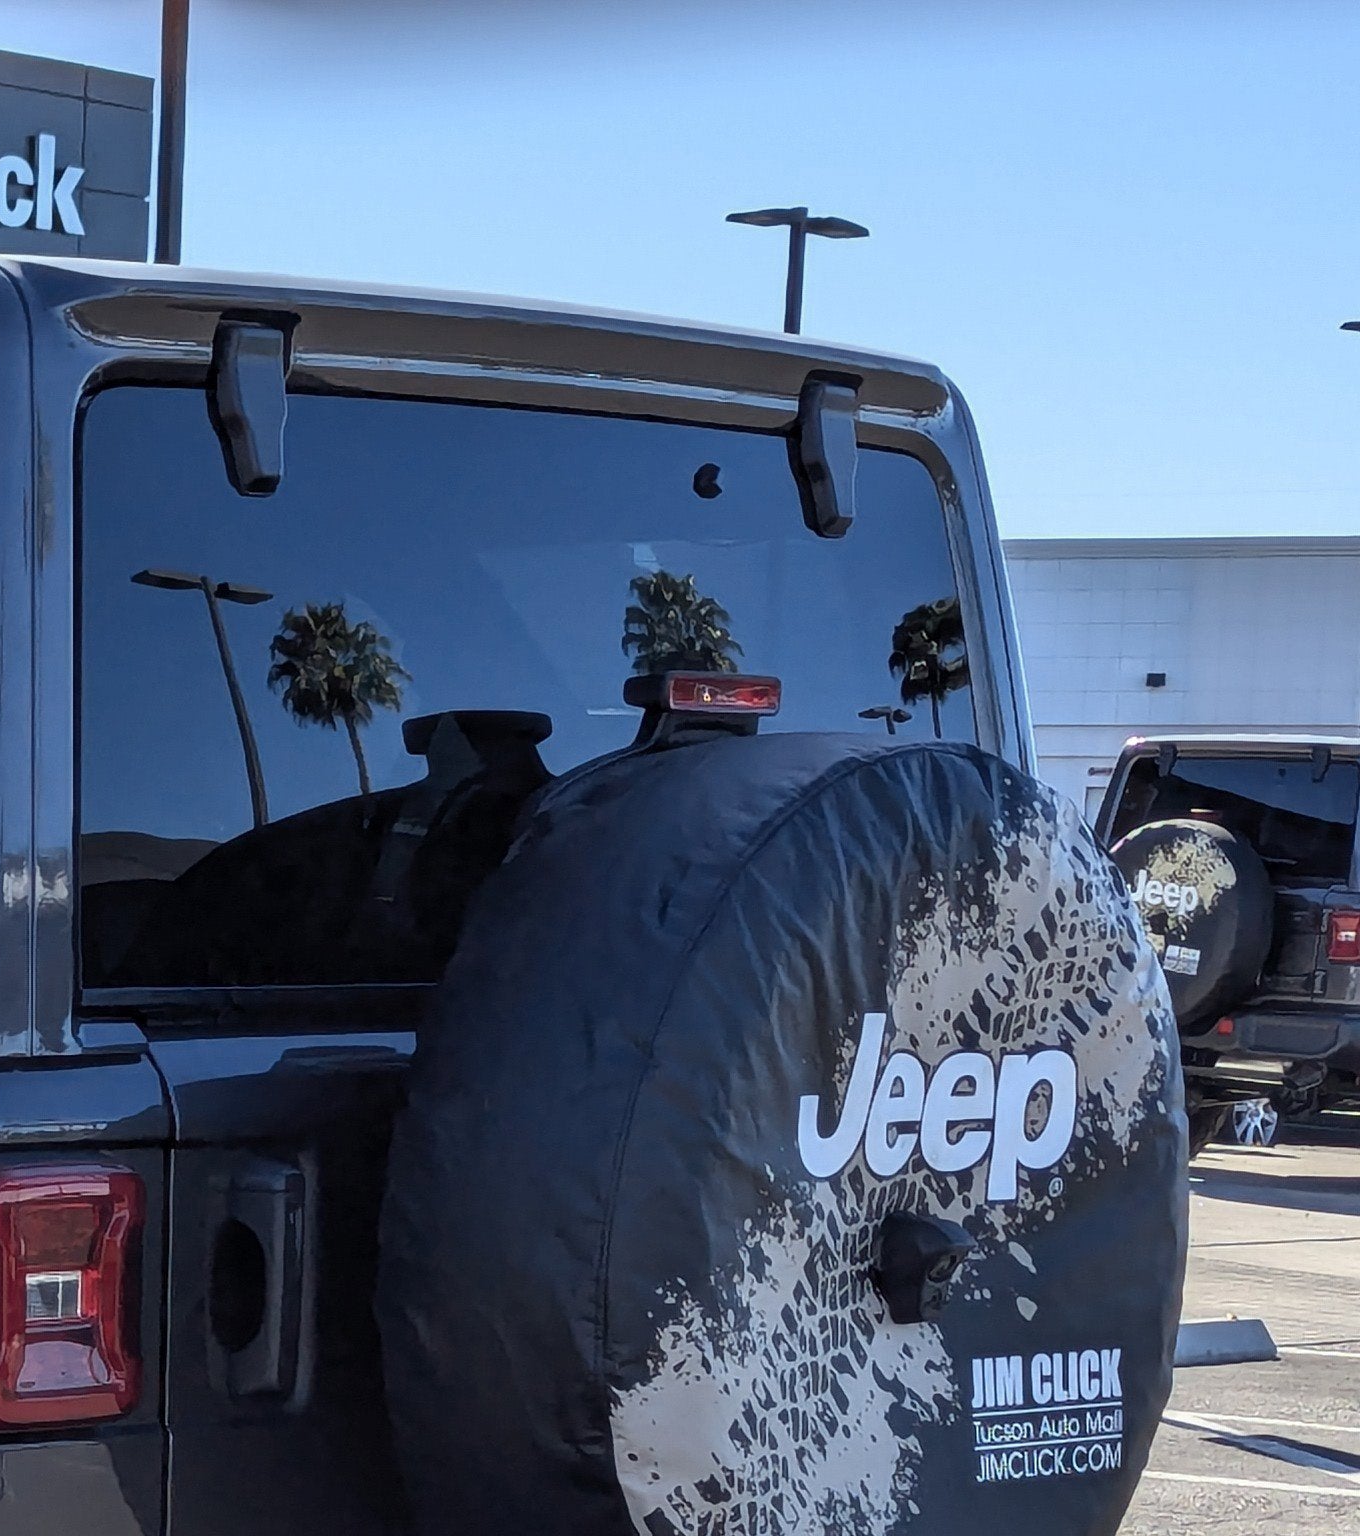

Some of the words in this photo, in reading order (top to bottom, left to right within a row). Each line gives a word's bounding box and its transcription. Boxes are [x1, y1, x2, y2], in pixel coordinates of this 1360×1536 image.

[1128, 869, 1199, 915] Jeep
[797, 1012, 1076, 1200] Jeep
[971, 1355, 1024, 1408] JIM
[1031, 1348, 1123, 1404] CLICK
[973, 1421, 1034, 1444] Tucson
[1039, 1414, 1080, 1438] Auto
[1085, 1409, 1123, 1434] Mall
[976, 1442, 1122, 1482] JIMCLICK.COM
